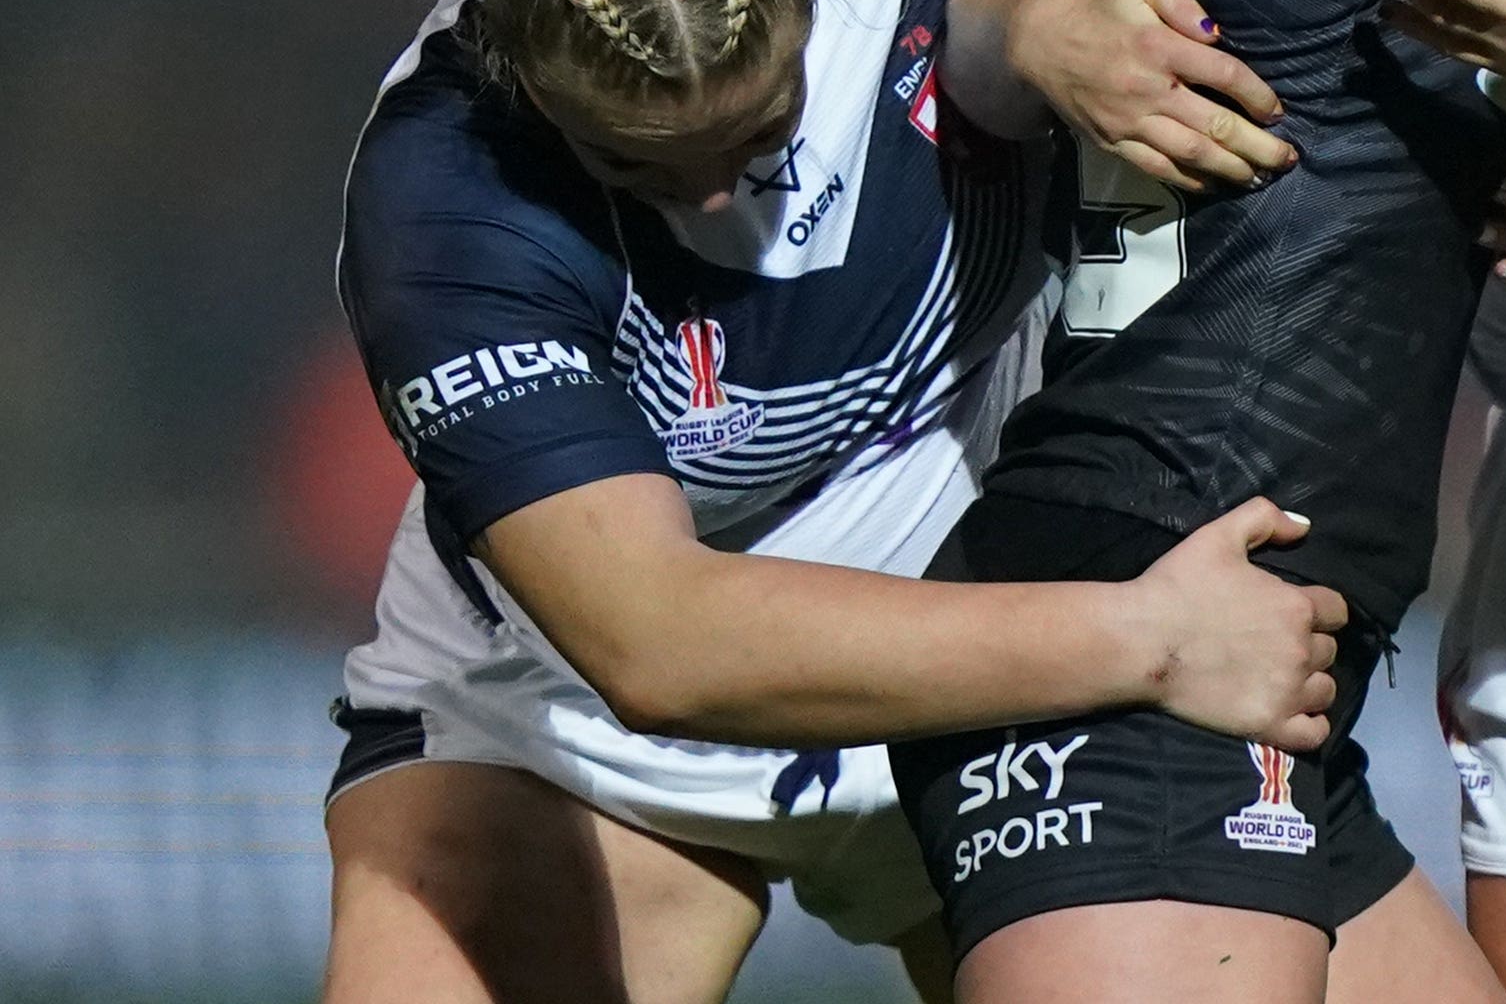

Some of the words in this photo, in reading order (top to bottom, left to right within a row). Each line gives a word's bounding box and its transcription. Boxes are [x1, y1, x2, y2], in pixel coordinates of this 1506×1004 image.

[900, 24, 934, 57] 78
[787, 171, 845, 246] OXEN
[399, 340, 593, 427] REIGN
[418, 405, 475, 441] TOTAL
[482, 379, 540, 410] BODY
[551, 371, 604, 387] FUEL
[665, 428, 724, 447] WORLD
[728, 410, 761, 435] CUP
[957, 734, 1090, 816] SKY
[953, 801, 1104, 883] SPORT
[1229, 820, 1285, 838] WORLD
[1287, 825, 1313, 841] CUP
